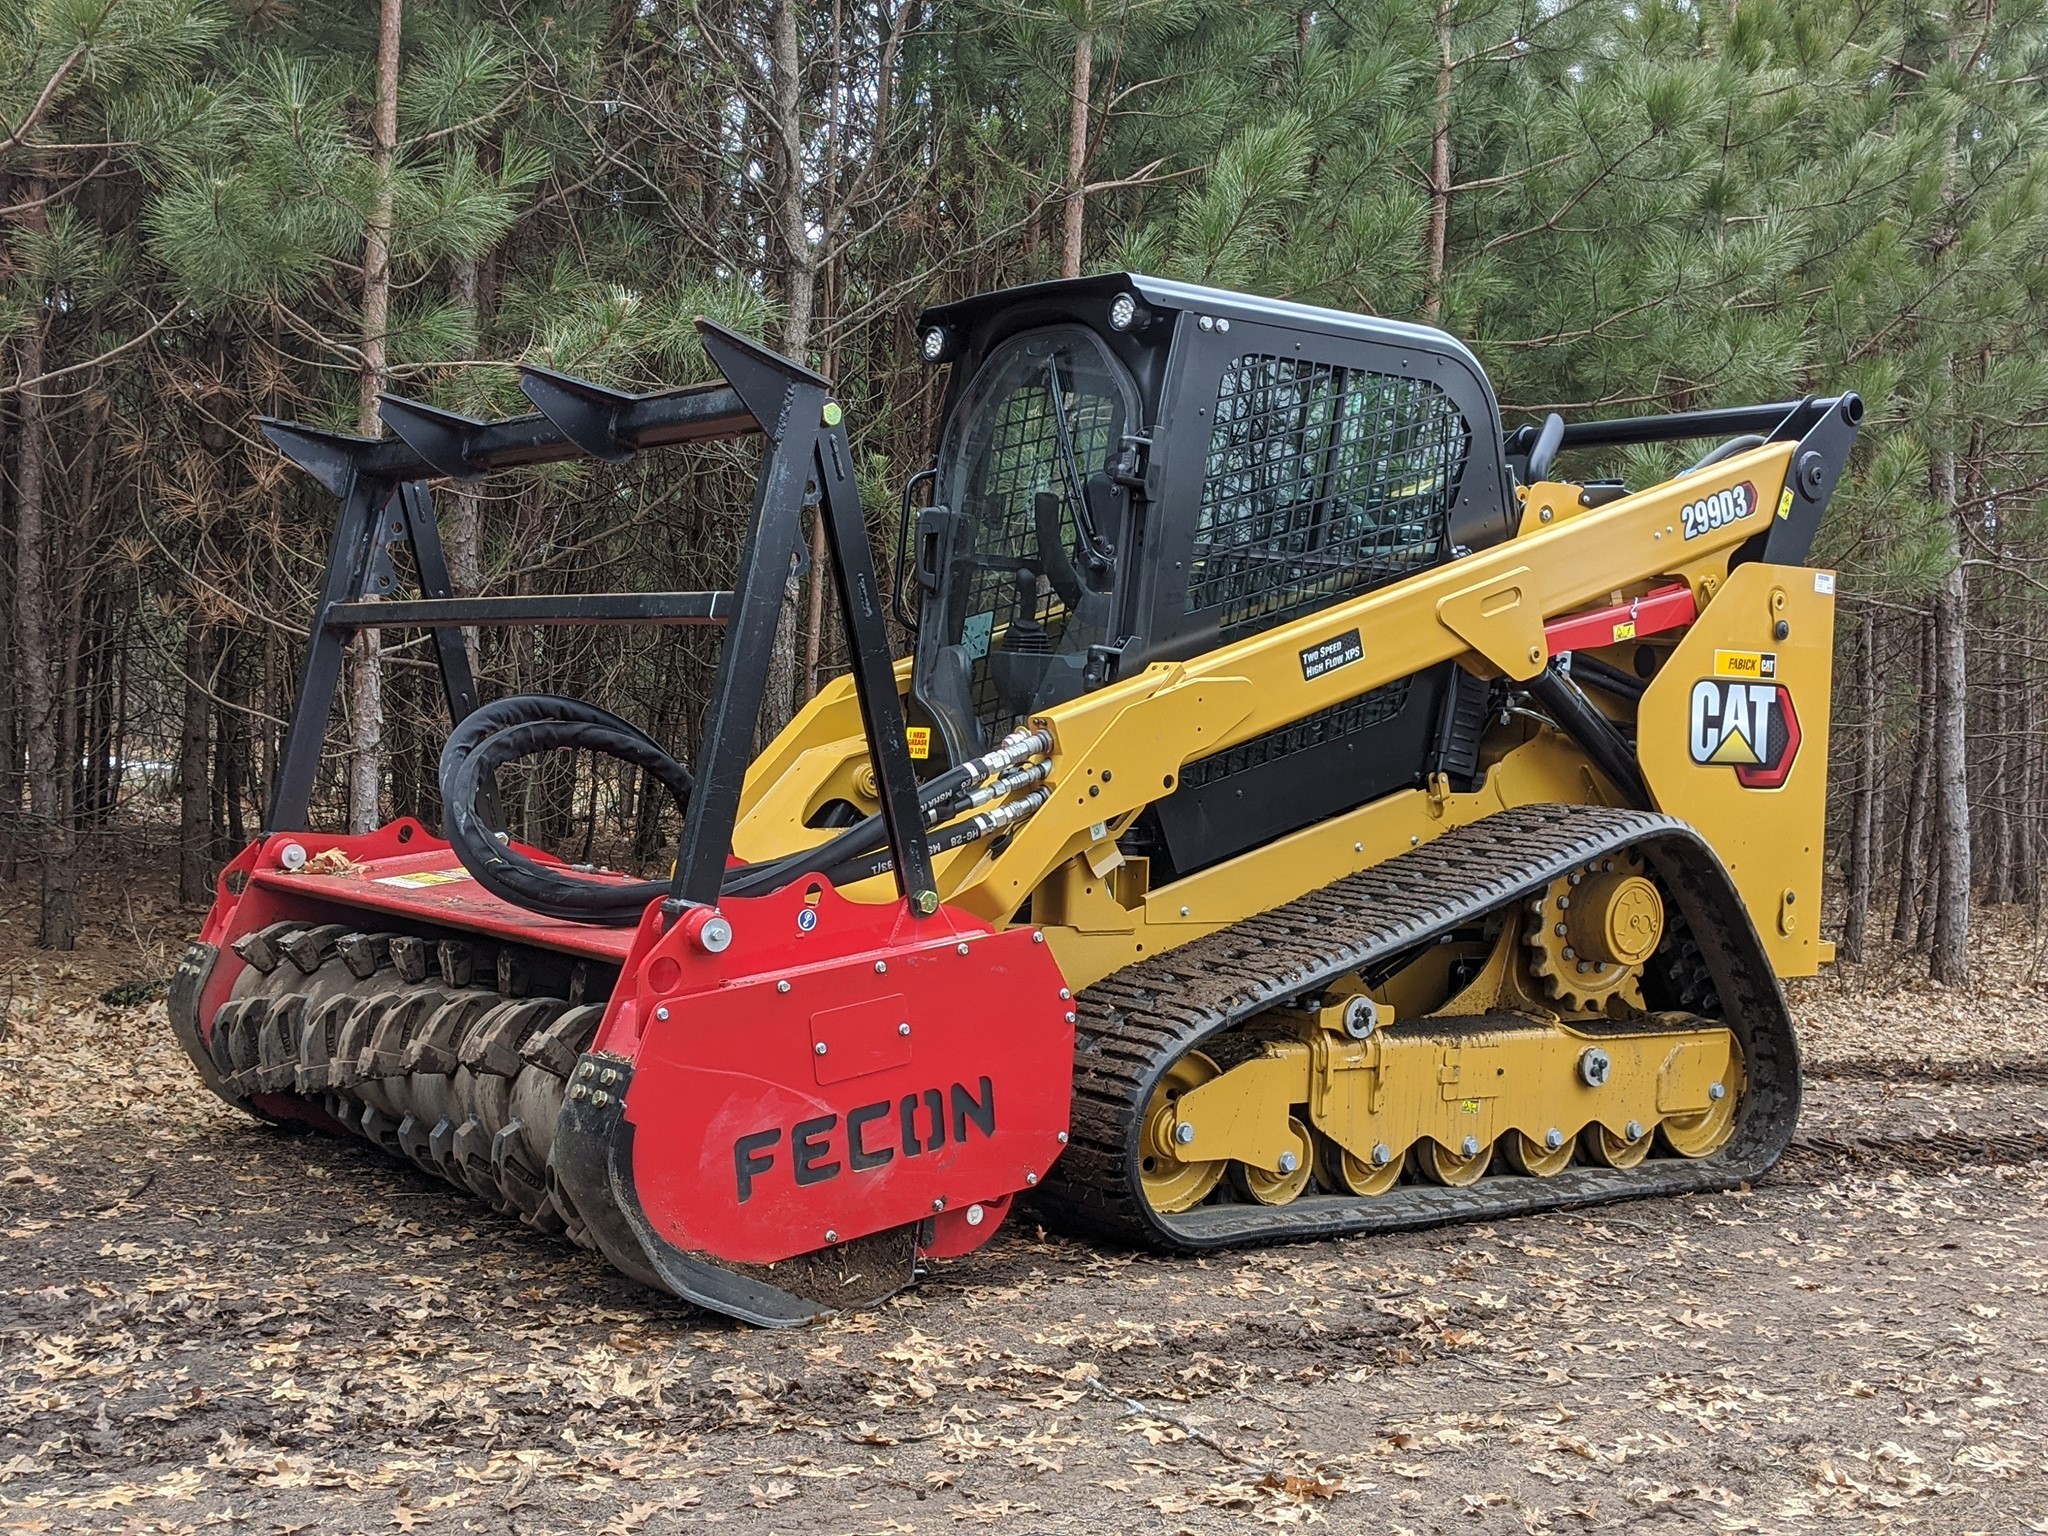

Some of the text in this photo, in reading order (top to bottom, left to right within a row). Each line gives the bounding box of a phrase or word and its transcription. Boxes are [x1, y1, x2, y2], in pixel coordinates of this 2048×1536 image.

[1681, 484, 1748, 540] 299D3
[1345, 645, 1360, 662] XPS
[1728, 657, 1775, 673] FABICK CAT
[1690, 680, 1777, 764] CAT
[913, 731, 927, 739] NEED
[915, 747, 927, 755] LIVE
[950, 828, 979, 847] HG-28
[734, 1074, 996, 1206] FECON
